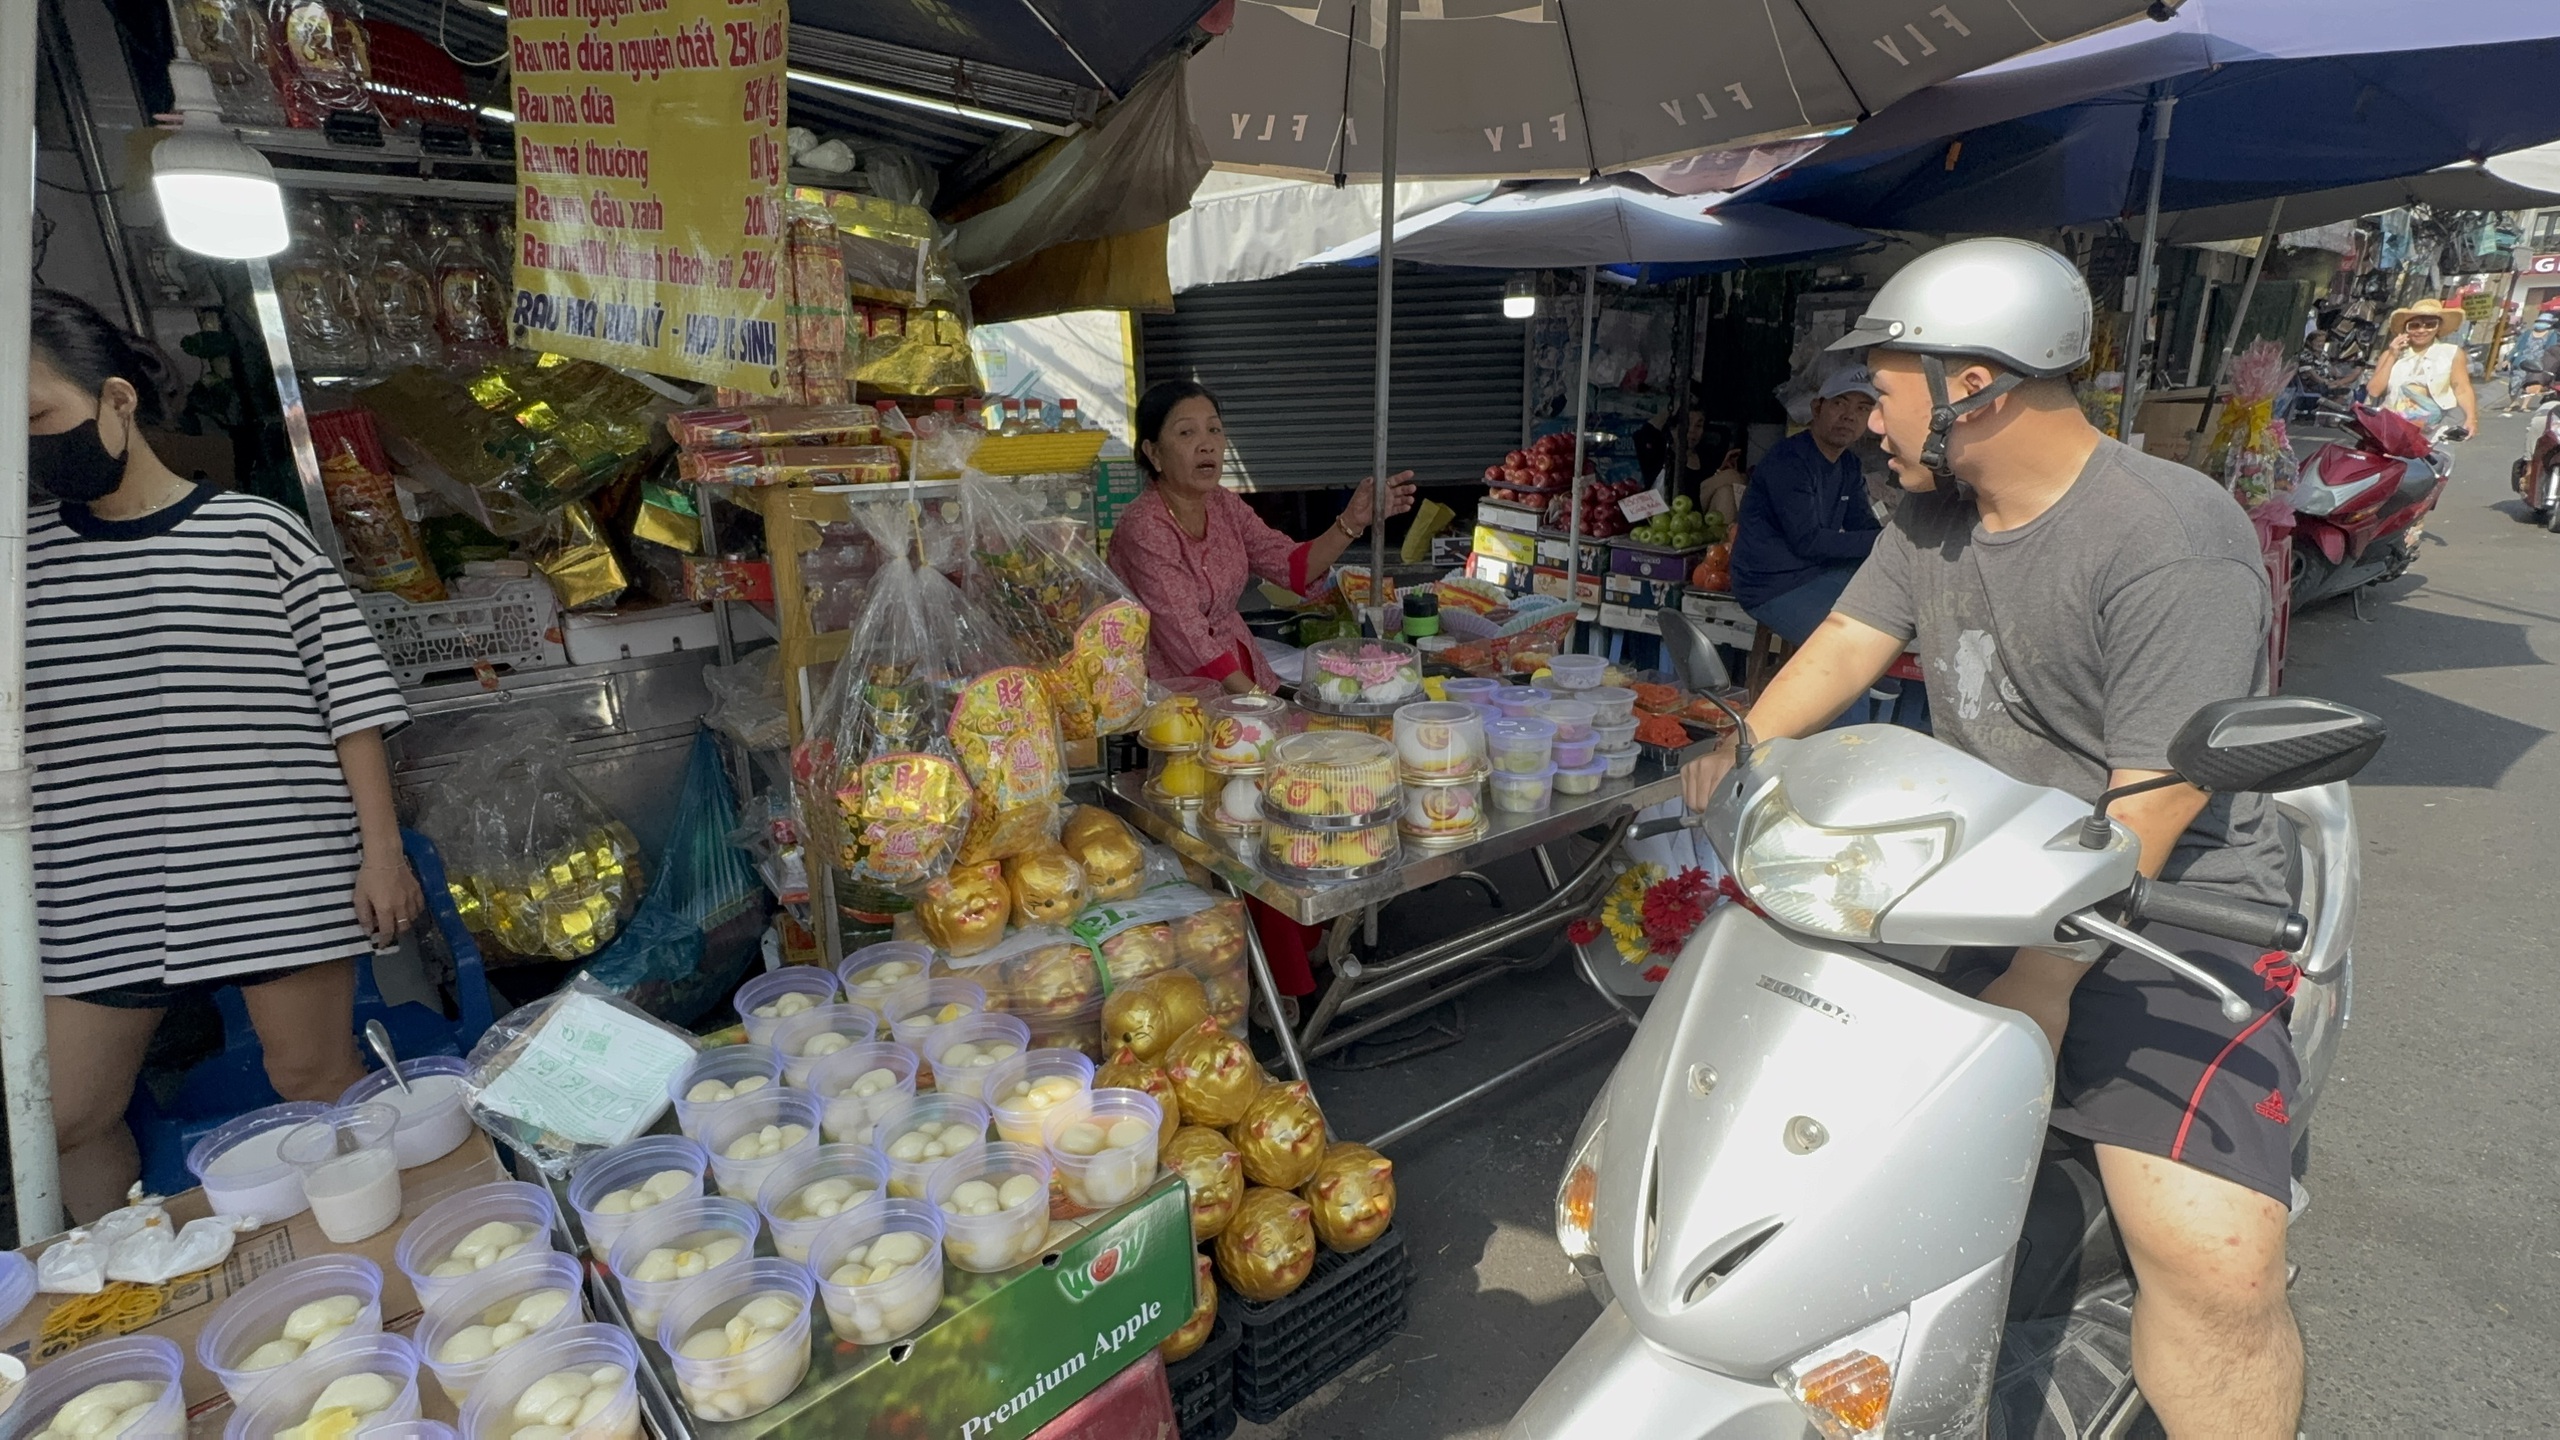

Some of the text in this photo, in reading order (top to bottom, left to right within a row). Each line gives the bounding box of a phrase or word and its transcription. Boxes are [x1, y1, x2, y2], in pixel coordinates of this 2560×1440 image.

[513, 35, 543, 72] Rau
[542, 32, 571, 71] má
[577, 33, 614, 72] dừa
[618, 28, 675, 82] nguyên
[676, 17, 719, 68] chất
[517, 86, 549, 123] Rau
[552, 86, 578, 124] má
[580, 86, 615, 125] dừa
[521, 136, 552, 172] Rau
[554, 139, 580, 175] má
[585, 139, 648, 189] thường
[591, 190, 625, 236] đậu
[630, 193, 663, 230] xanh
[523, 232, 556, 270] Rau
[513, 290, 560, 332] RAU
[565, 292, 598, 338] MÁ
[740, 318, 777, 366] SINH
[960, 1300, 1162, 1440] Premium Apple
